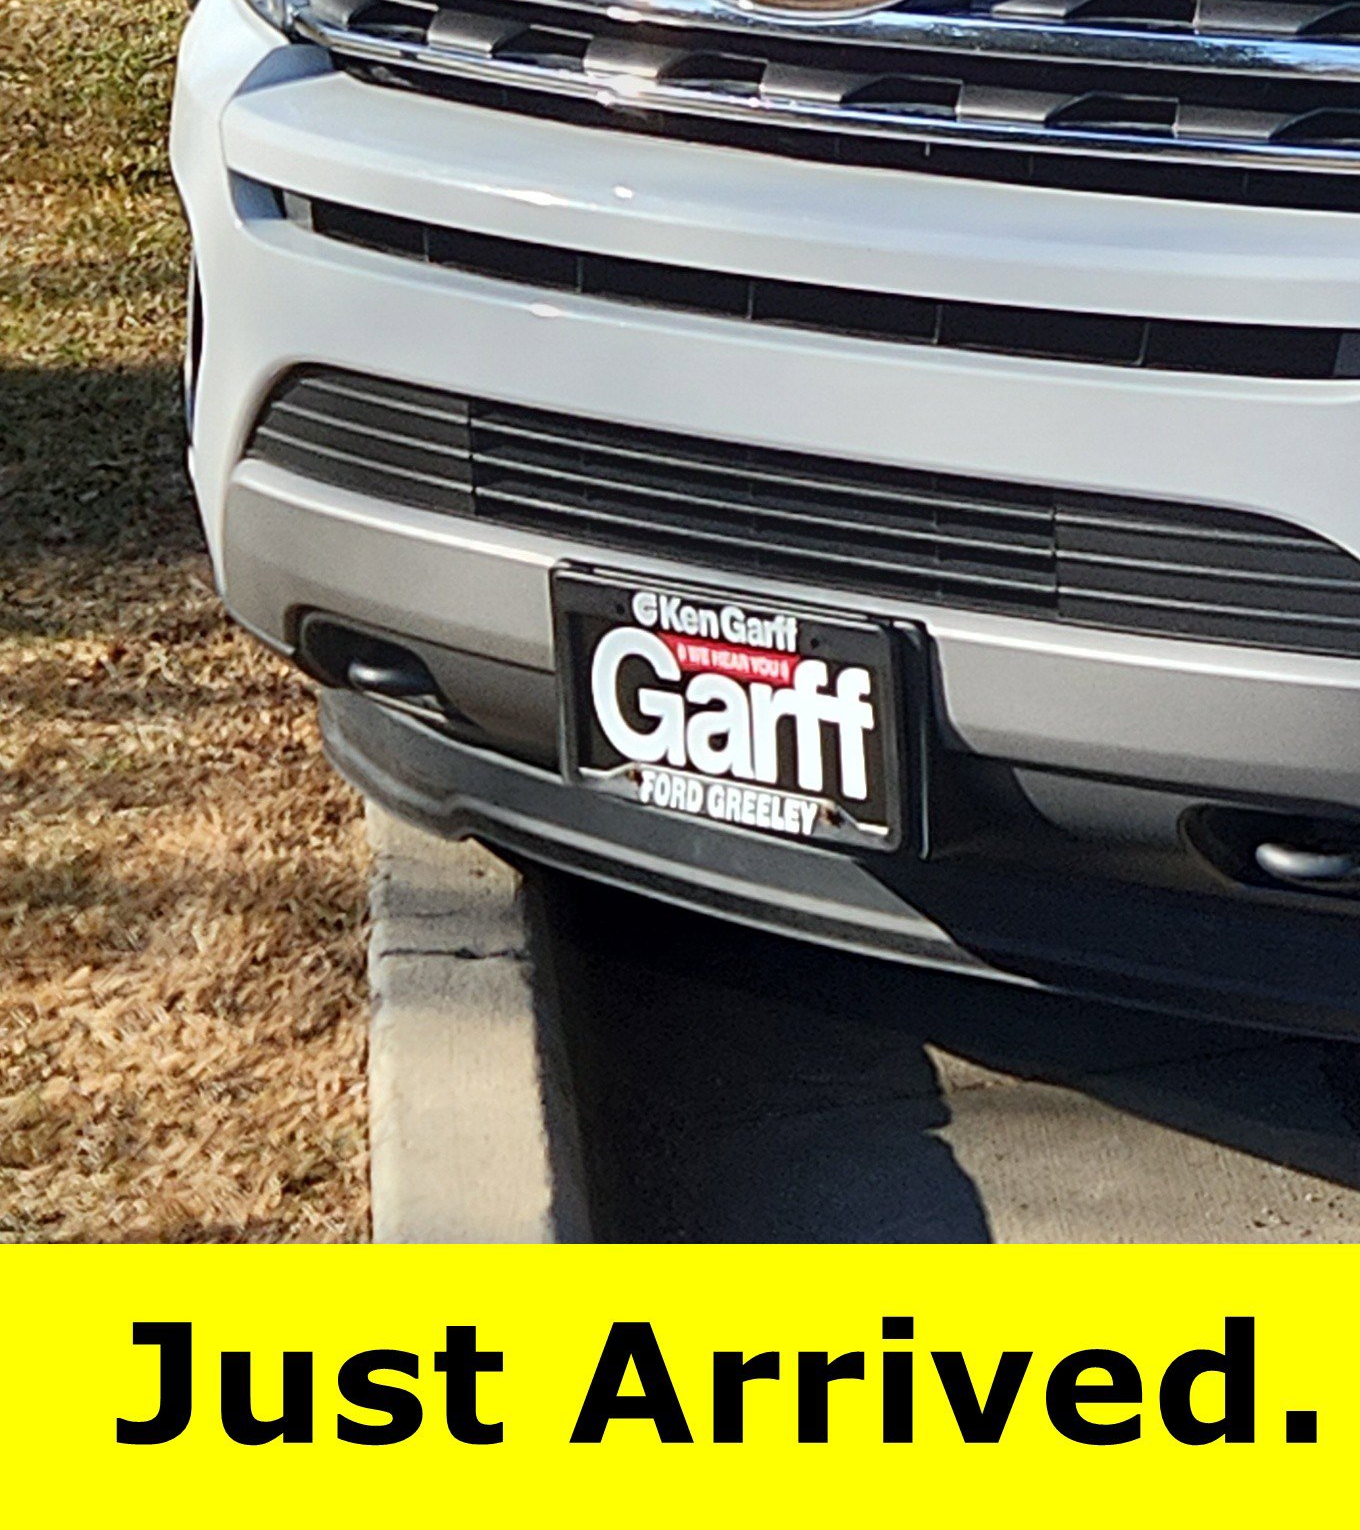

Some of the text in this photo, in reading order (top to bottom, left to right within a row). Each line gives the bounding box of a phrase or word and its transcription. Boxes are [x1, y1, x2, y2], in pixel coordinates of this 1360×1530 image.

[659, 594, 799, 653] Ken Garff
[750, 655, 780, 678] YOU
[590, 626, 875, 801] Garff
[639, 769, 820, 837] FORD GREELEY
